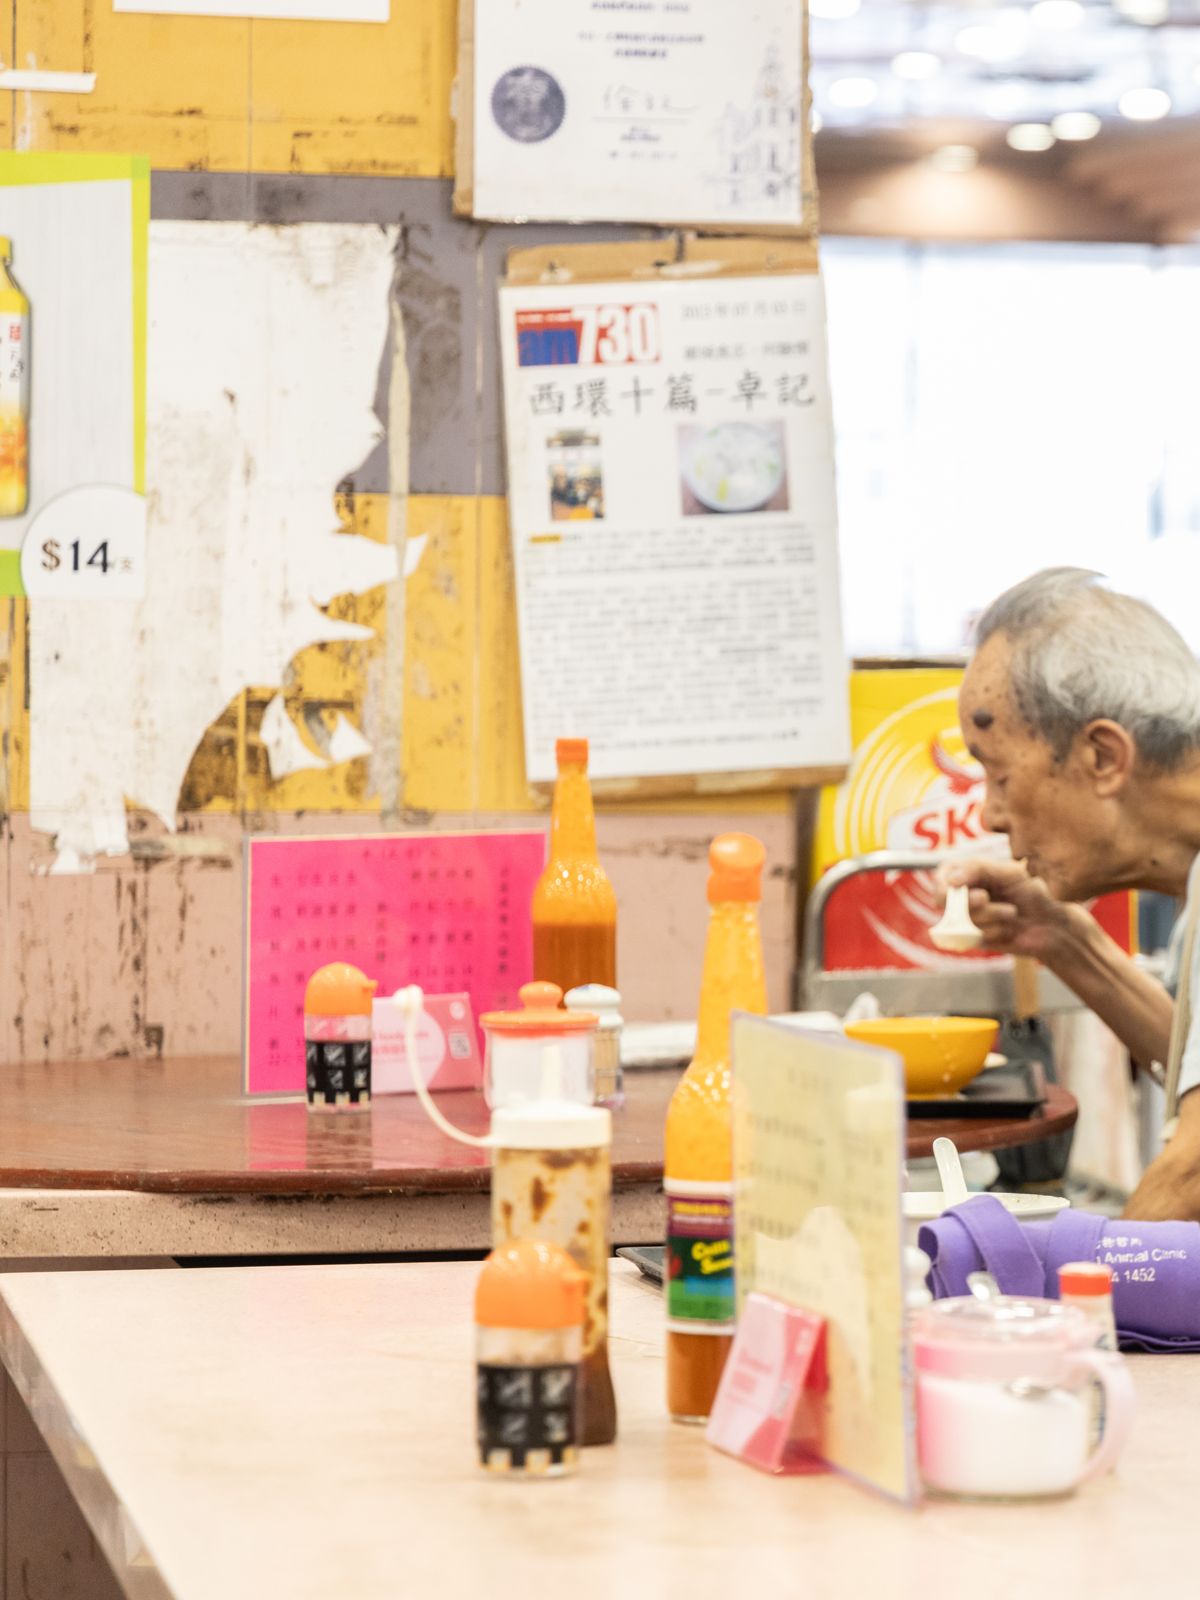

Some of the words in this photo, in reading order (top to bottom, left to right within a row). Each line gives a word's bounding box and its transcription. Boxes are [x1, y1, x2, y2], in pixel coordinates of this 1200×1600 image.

[529, 369, 817, 419] 西環十篇-卓記
[41, 536, 114, 573] $14
[1104, 1250, 1149, 1264] Animal
[1152, 1248, 1188, 1262] Clinic
[1124, 1267, 1156, 1283] 1452
